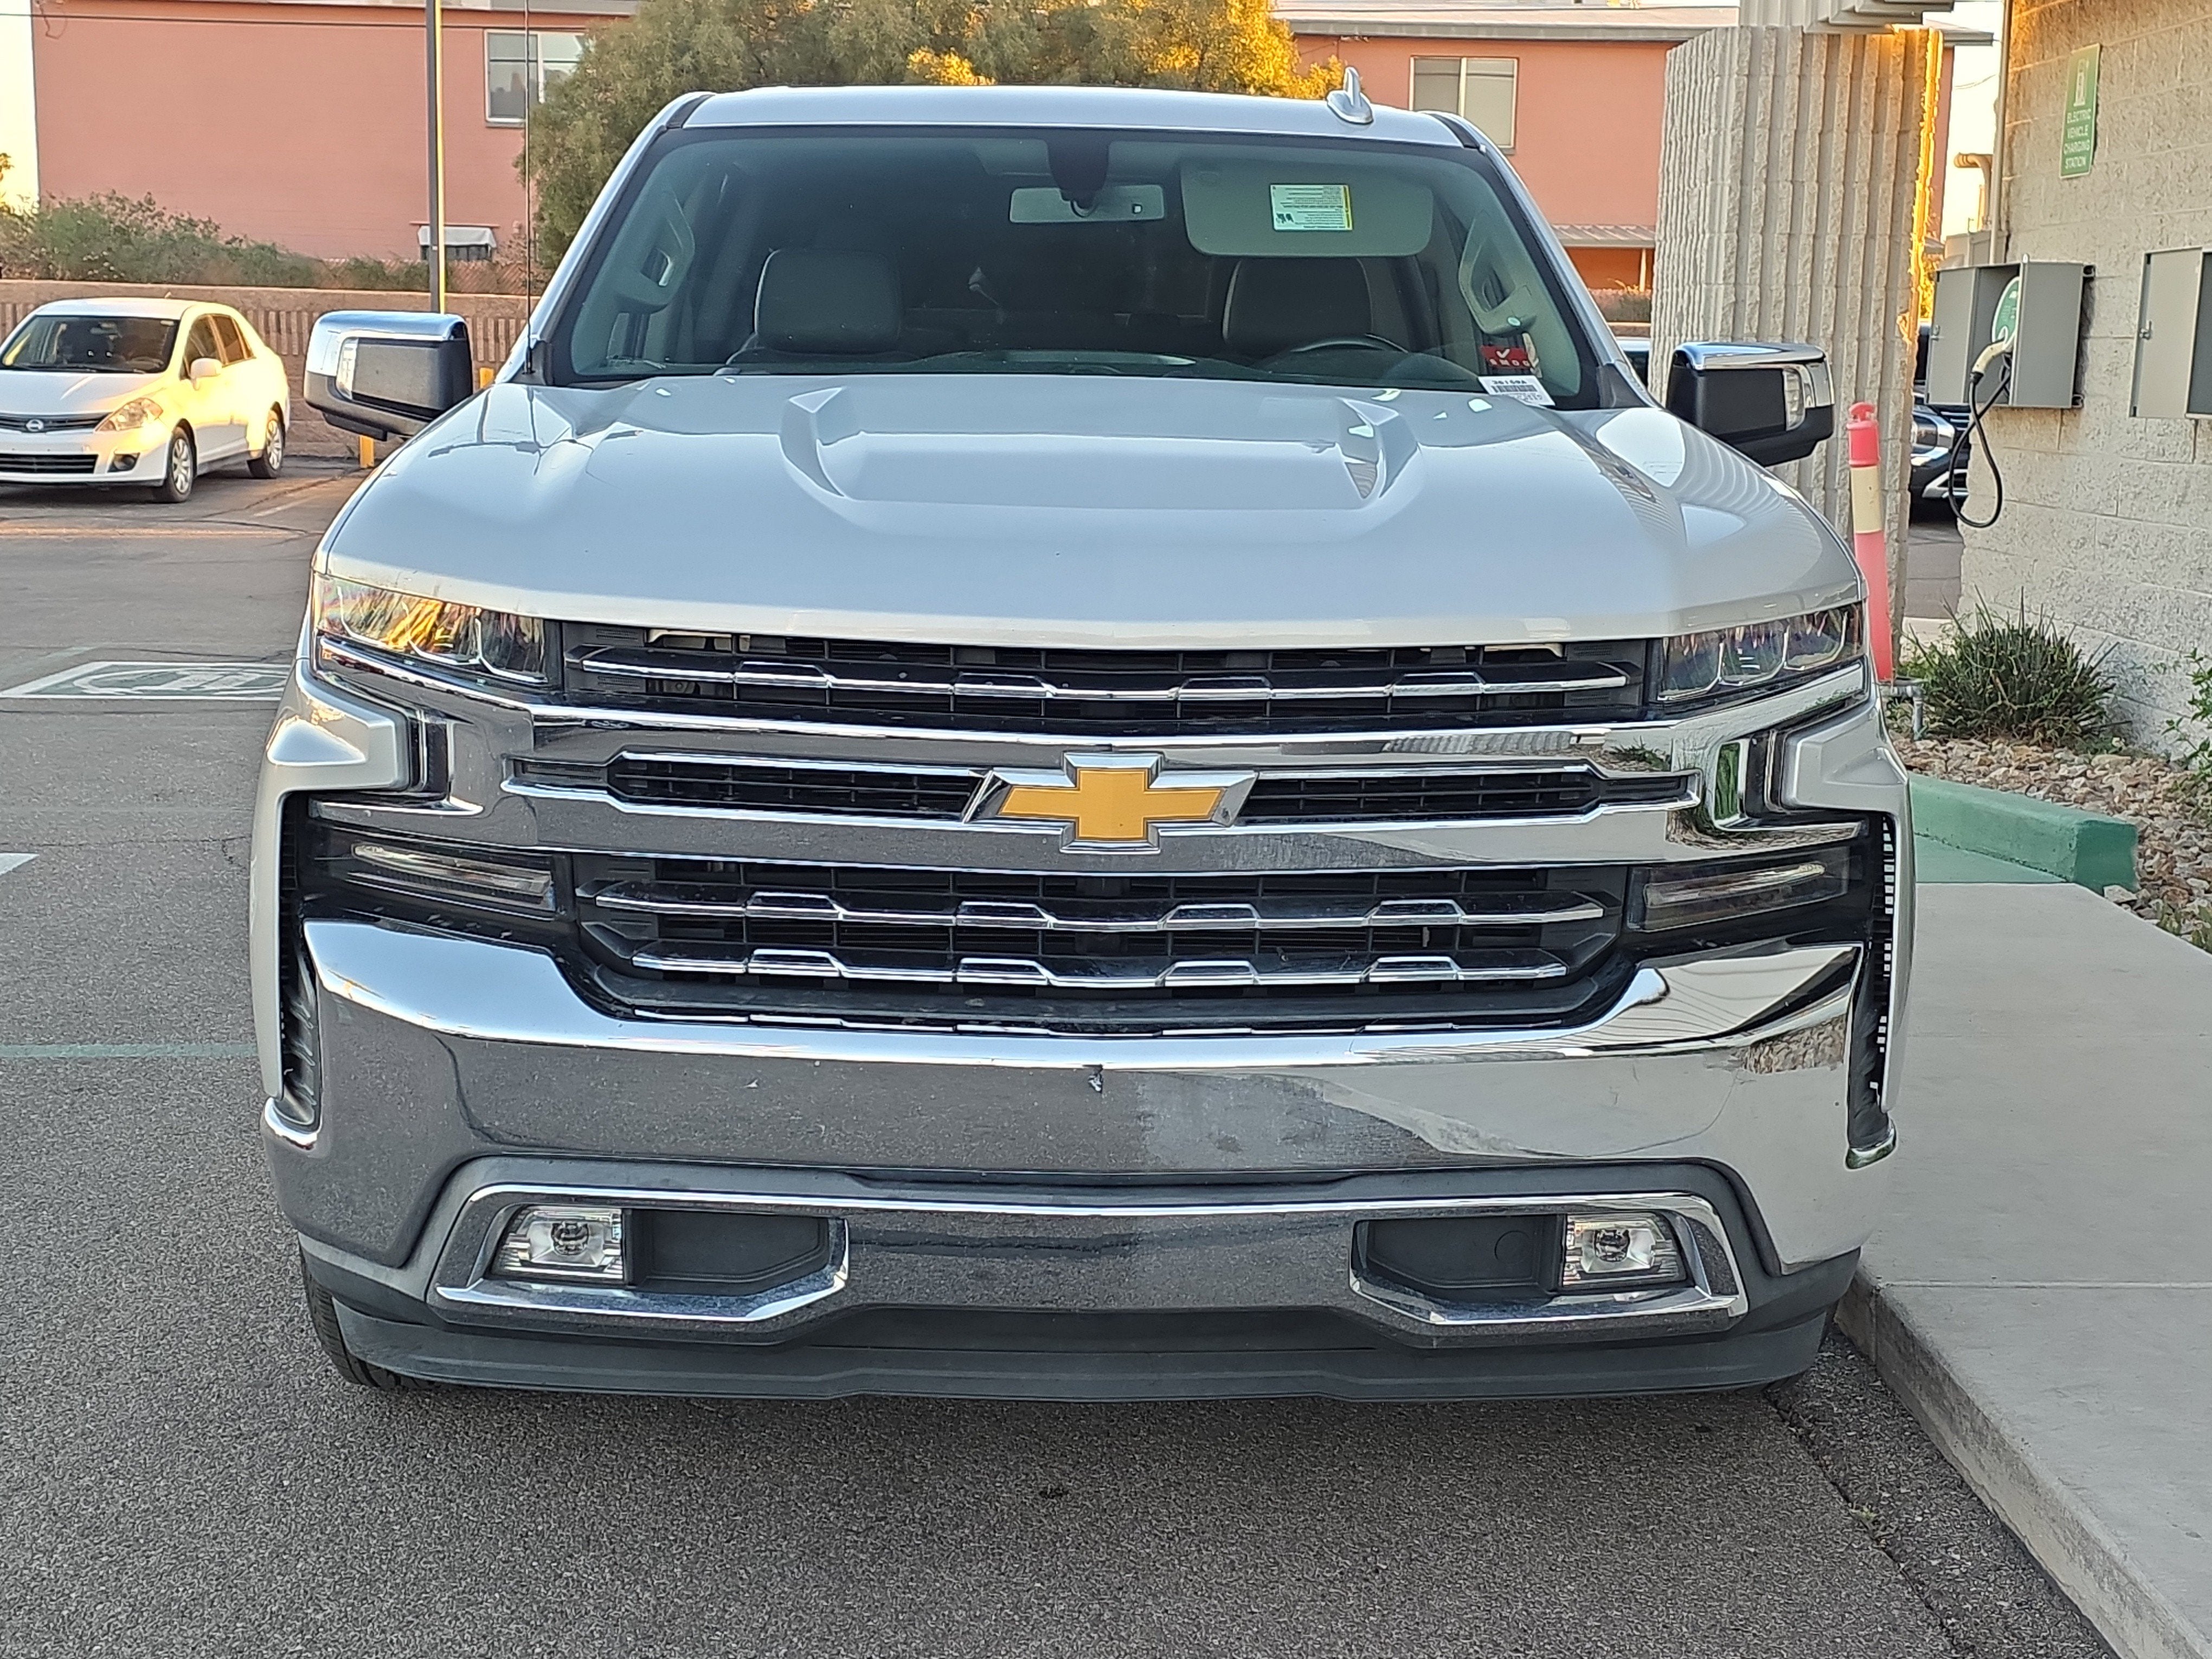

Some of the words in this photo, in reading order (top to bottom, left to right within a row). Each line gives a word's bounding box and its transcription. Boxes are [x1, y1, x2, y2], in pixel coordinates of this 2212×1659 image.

[2066, 108, 2091, 124] ELECTRIC
[2067, 125, 2088, 138] VEHICLE
[2063, 139, 2090, 155] CHARGING
[2065, 156, 2086, 169] STATION
